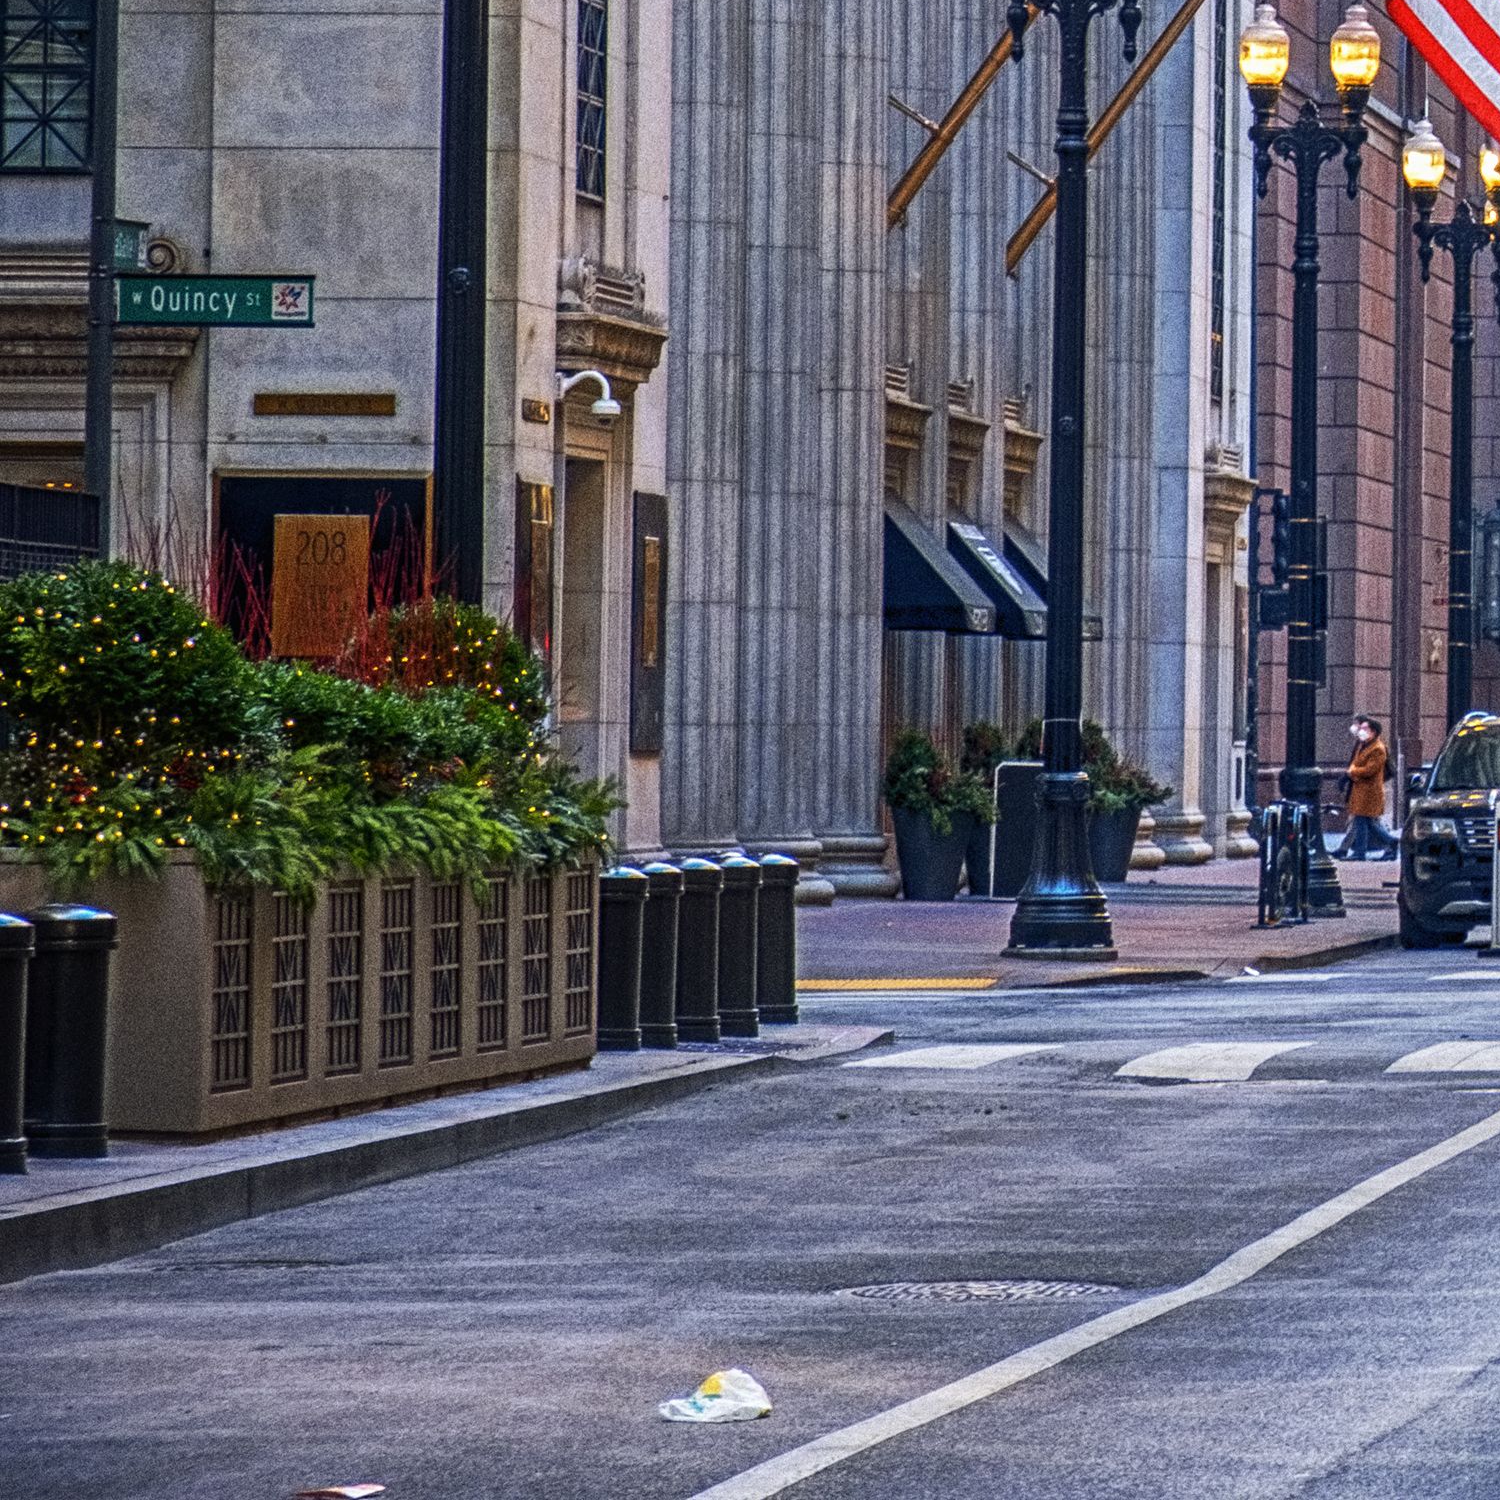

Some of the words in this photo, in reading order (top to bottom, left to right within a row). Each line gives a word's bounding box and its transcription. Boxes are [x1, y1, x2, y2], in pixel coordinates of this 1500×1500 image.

[132, 291, 143, 304] W
[150, 285, 237, 319] Quincy
[246, 292, 261, 306] St
[297, 530, 347, 565] 208
